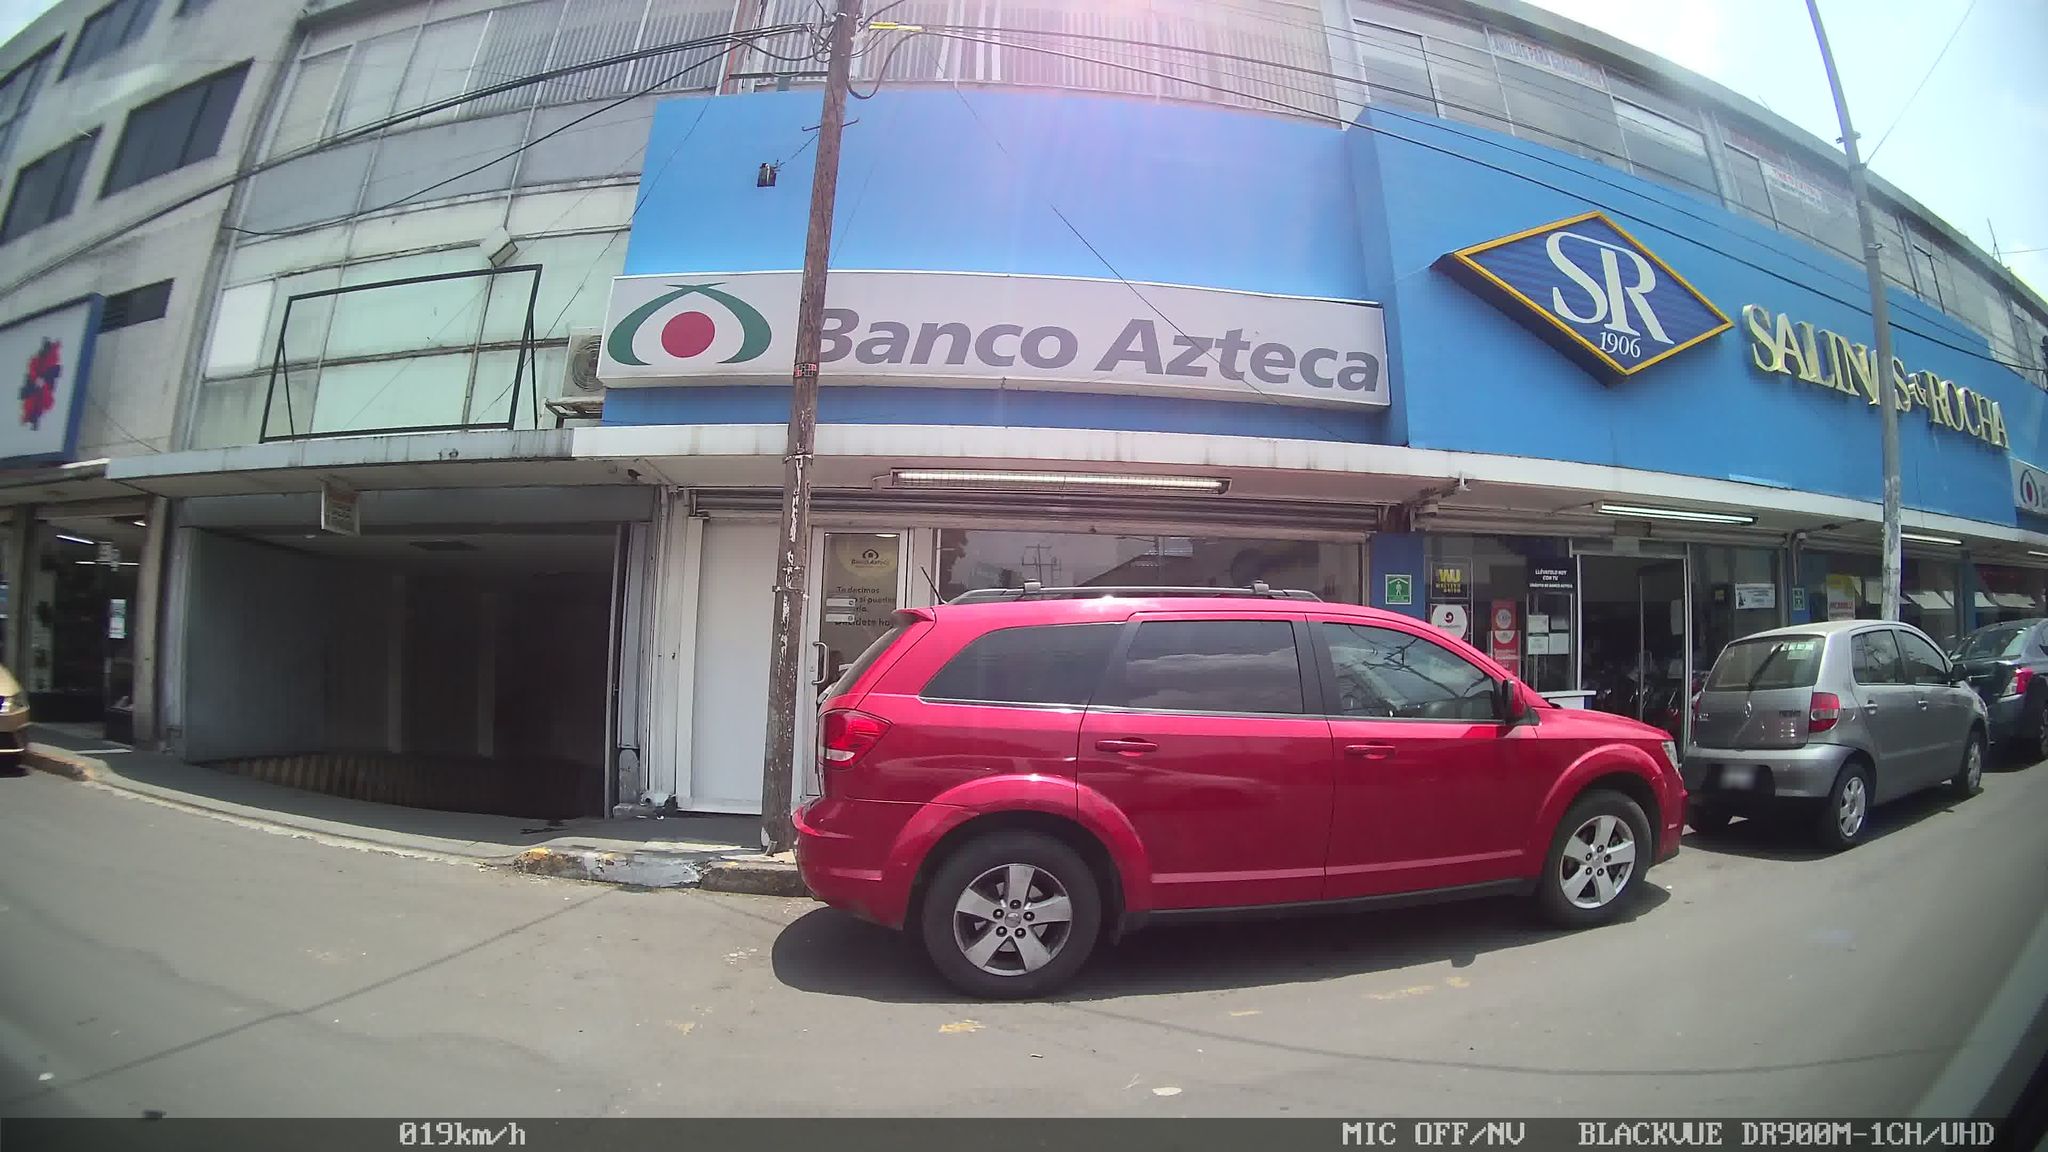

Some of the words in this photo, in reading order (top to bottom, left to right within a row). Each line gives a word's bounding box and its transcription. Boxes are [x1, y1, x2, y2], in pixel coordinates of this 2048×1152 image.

[1546, 231, 1675, 345] SR
[819, 307, 1079, 370] Banco
[1093, 318, 1380, 392] Azteca
[1600, 331, 1642, 358] 1906
[1919, 369, 2009, 450] ROCHA
[1439, 568, 1461, 583] WU
